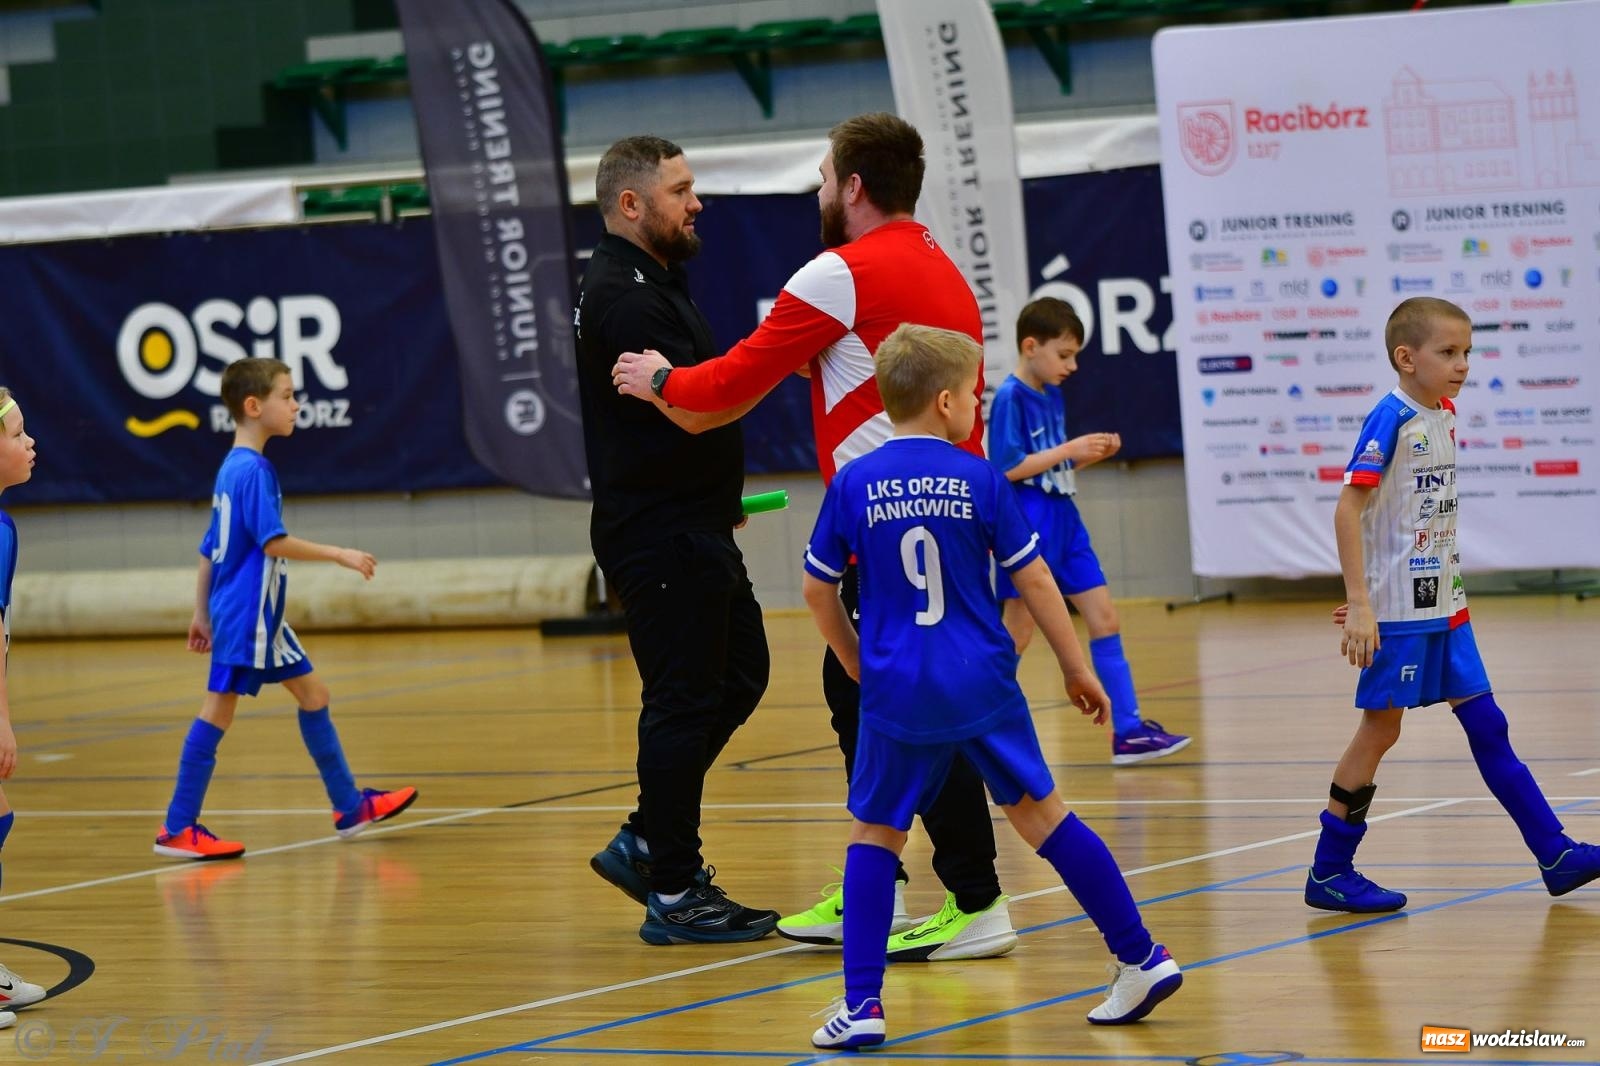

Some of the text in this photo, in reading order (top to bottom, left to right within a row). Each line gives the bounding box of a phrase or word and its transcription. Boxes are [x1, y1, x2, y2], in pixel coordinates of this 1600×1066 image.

[1245, 103, 1369, 134] Racibórz
[1221, 212, 1355, 233] JUNIOR TRENING
[1426, 201, 1567, 222] JUNIOR TRENING
[116, 294, 349, 400] OSiR
[867, 476, 971, 501] LKS ORZEŁ
[900, 525, 945, 626] 9
